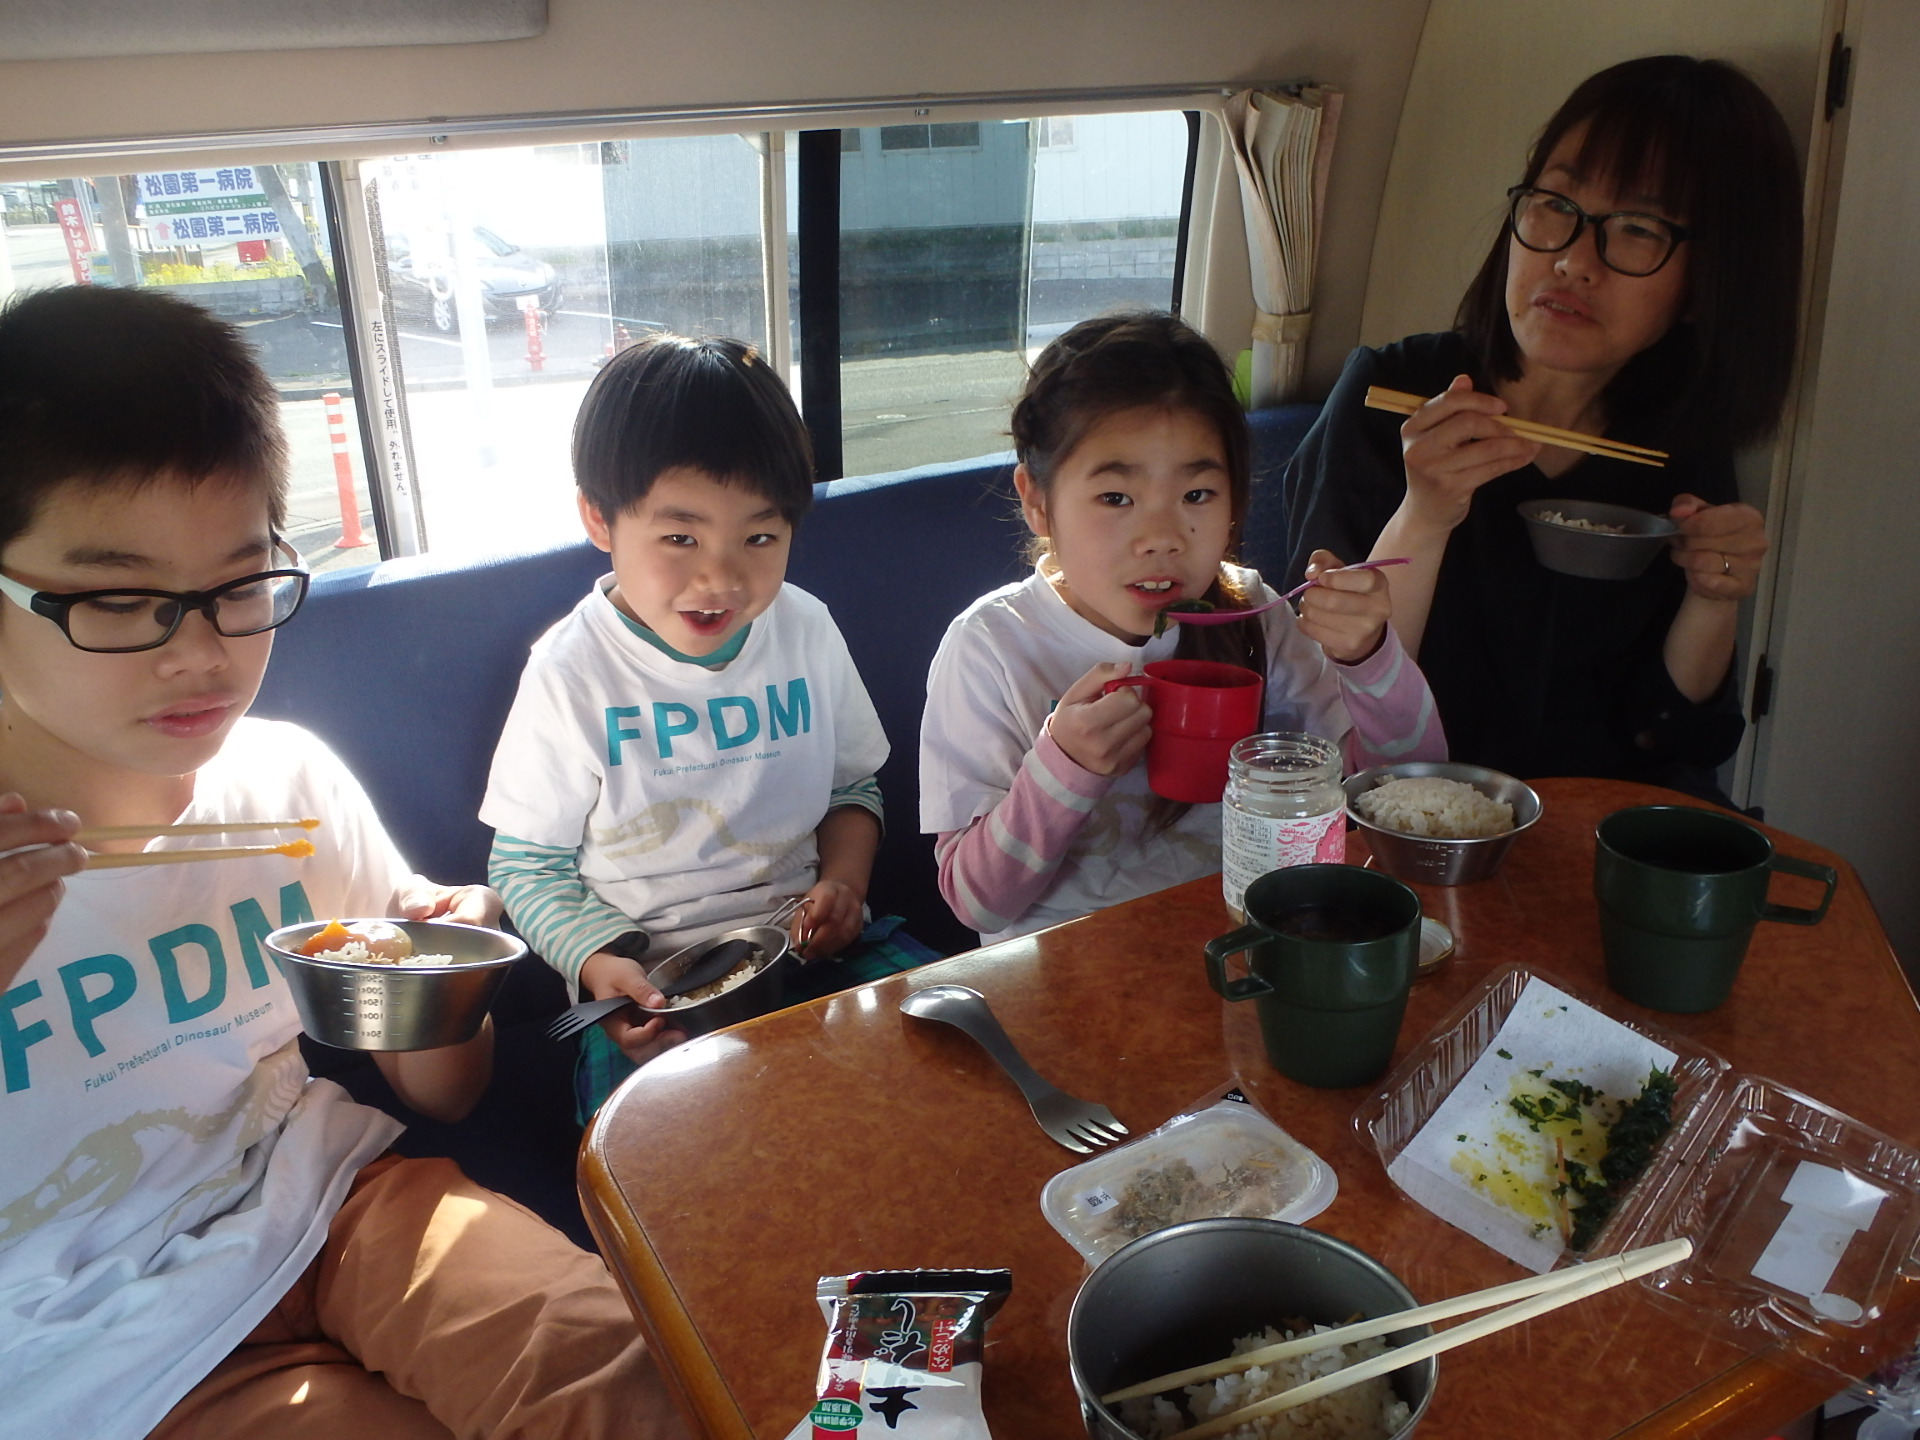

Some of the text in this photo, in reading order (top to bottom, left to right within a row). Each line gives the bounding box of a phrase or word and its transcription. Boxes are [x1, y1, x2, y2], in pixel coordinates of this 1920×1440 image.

[144, 167, 254, 197] 松園第一病院
[173, 211, 280, 240] 松園第二病院
[605, 677, 811, 767] FPDM
[653, 768, 674, 777] Fukui
[676, 761, 718, 773] Prefectural
[719, 755, 753, 767] Dinosaur
[0, 880, 316, 1094] FPDM
[84, 1001, 275, 1093] Fukui Prefectural Dinosaur Museum
[931, 1320, 955, 1371] なめこ汁
